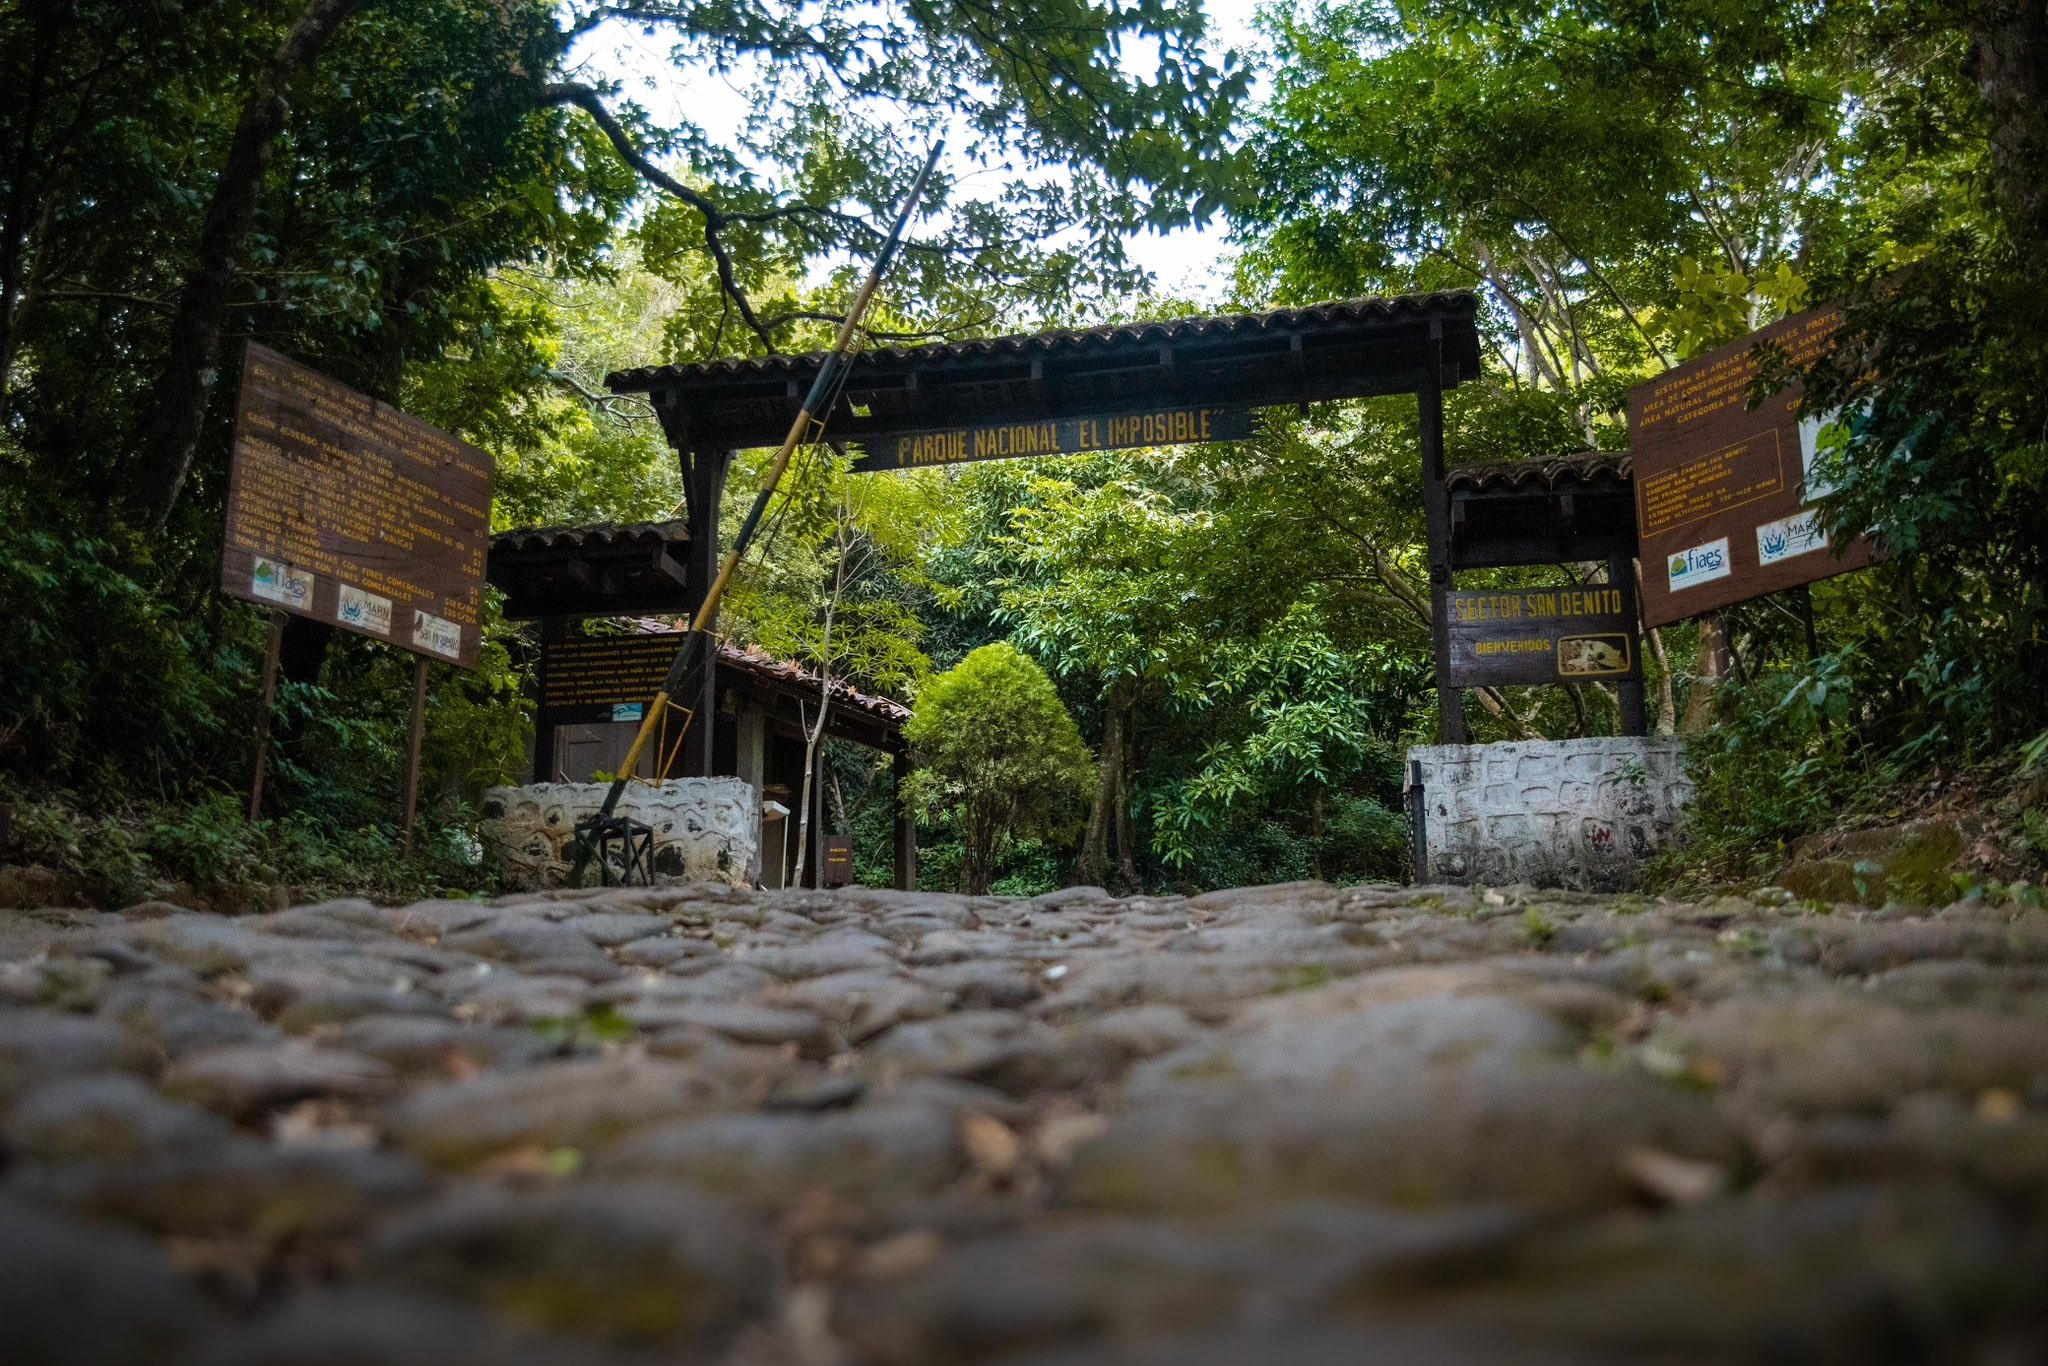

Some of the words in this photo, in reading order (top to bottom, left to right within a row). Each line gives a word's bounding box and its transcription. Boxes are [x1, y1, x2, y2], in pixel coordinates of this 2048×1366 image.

[1654, 374, 1691, 397] SISTEMA
[1664, 394, 1702, 417] NATURAL
[899, 431, 968, 464] PARQUE
[974, 424, 1060, 457] NACIONAL
[1688, 548, 1722, 573] fiaes
[363, 600, 389, 619] MARN
[1455, 596, 1522, 622] SECTOR
[1527, 593, 1557, 618] SAN
[1561, 590, 1622, 616] BENITO
[1475, 639, 1551, 655] BIENVENIDOS
